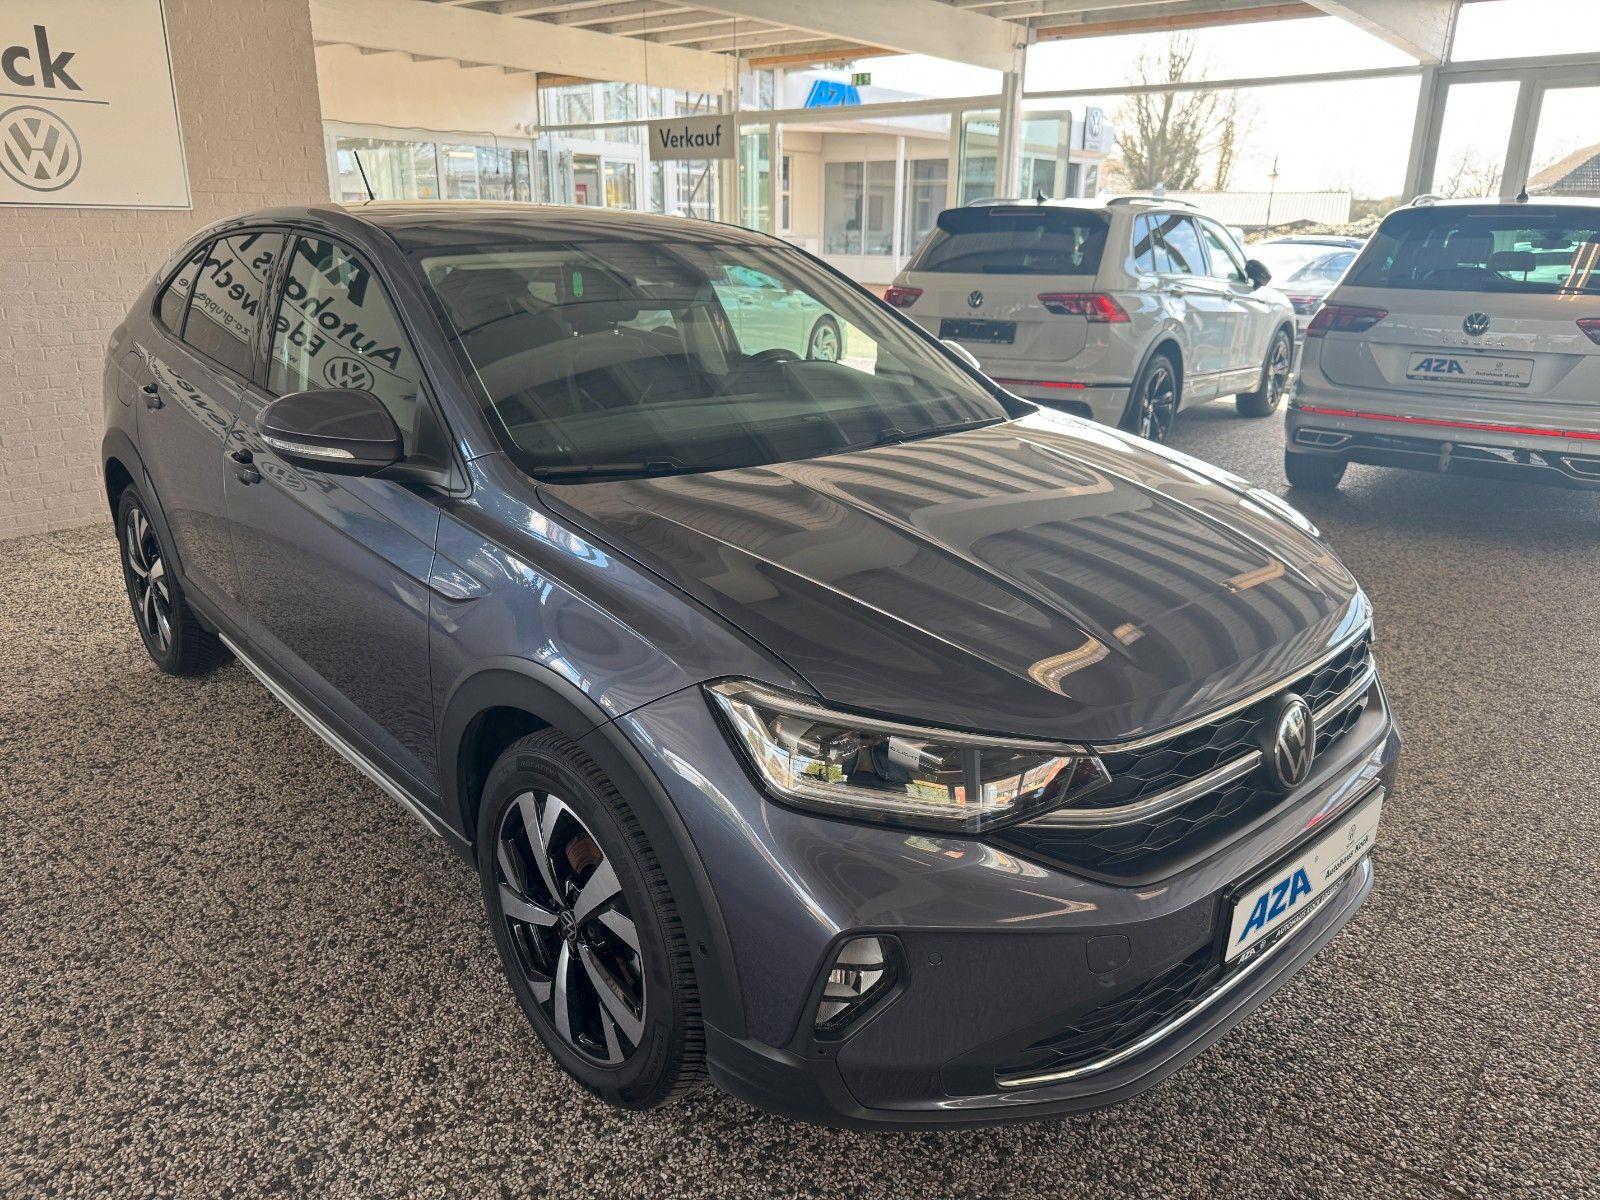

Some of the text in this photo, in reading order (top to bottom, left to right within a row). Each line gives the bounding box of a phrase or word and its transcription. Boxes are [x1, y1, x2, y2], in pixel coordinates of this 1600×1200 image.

[659, 123, 722, 149] Verkauf
[1413, 357, 1466, 375] AZA
[1237, 866, 1313, 945] AZA
